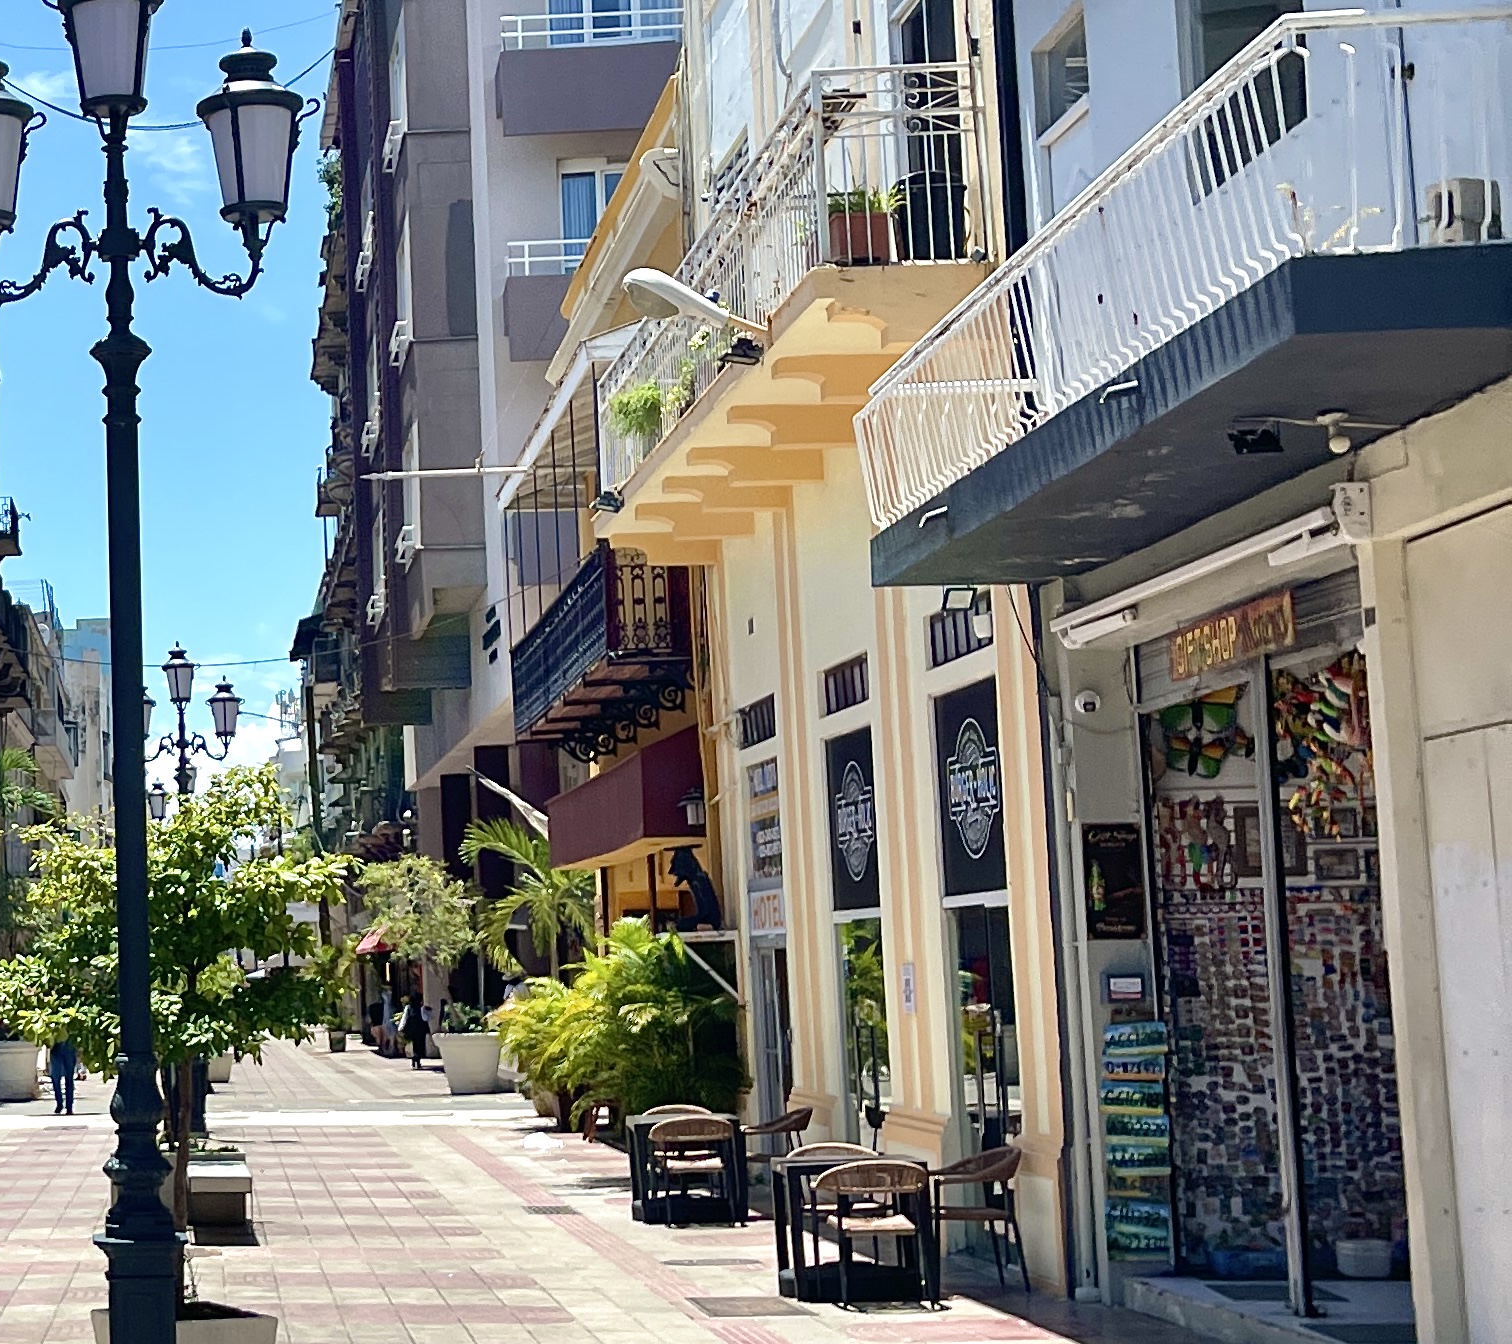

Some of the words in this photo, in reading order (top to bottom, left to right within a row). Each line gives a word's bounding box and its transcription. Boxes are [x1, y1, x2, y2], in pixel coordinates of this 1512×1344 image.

[1175, 627, 1202, 674] GIFT
[1203, 616, 1236, 666] SHOP
[753, 894, 785, 930] HOTEL
